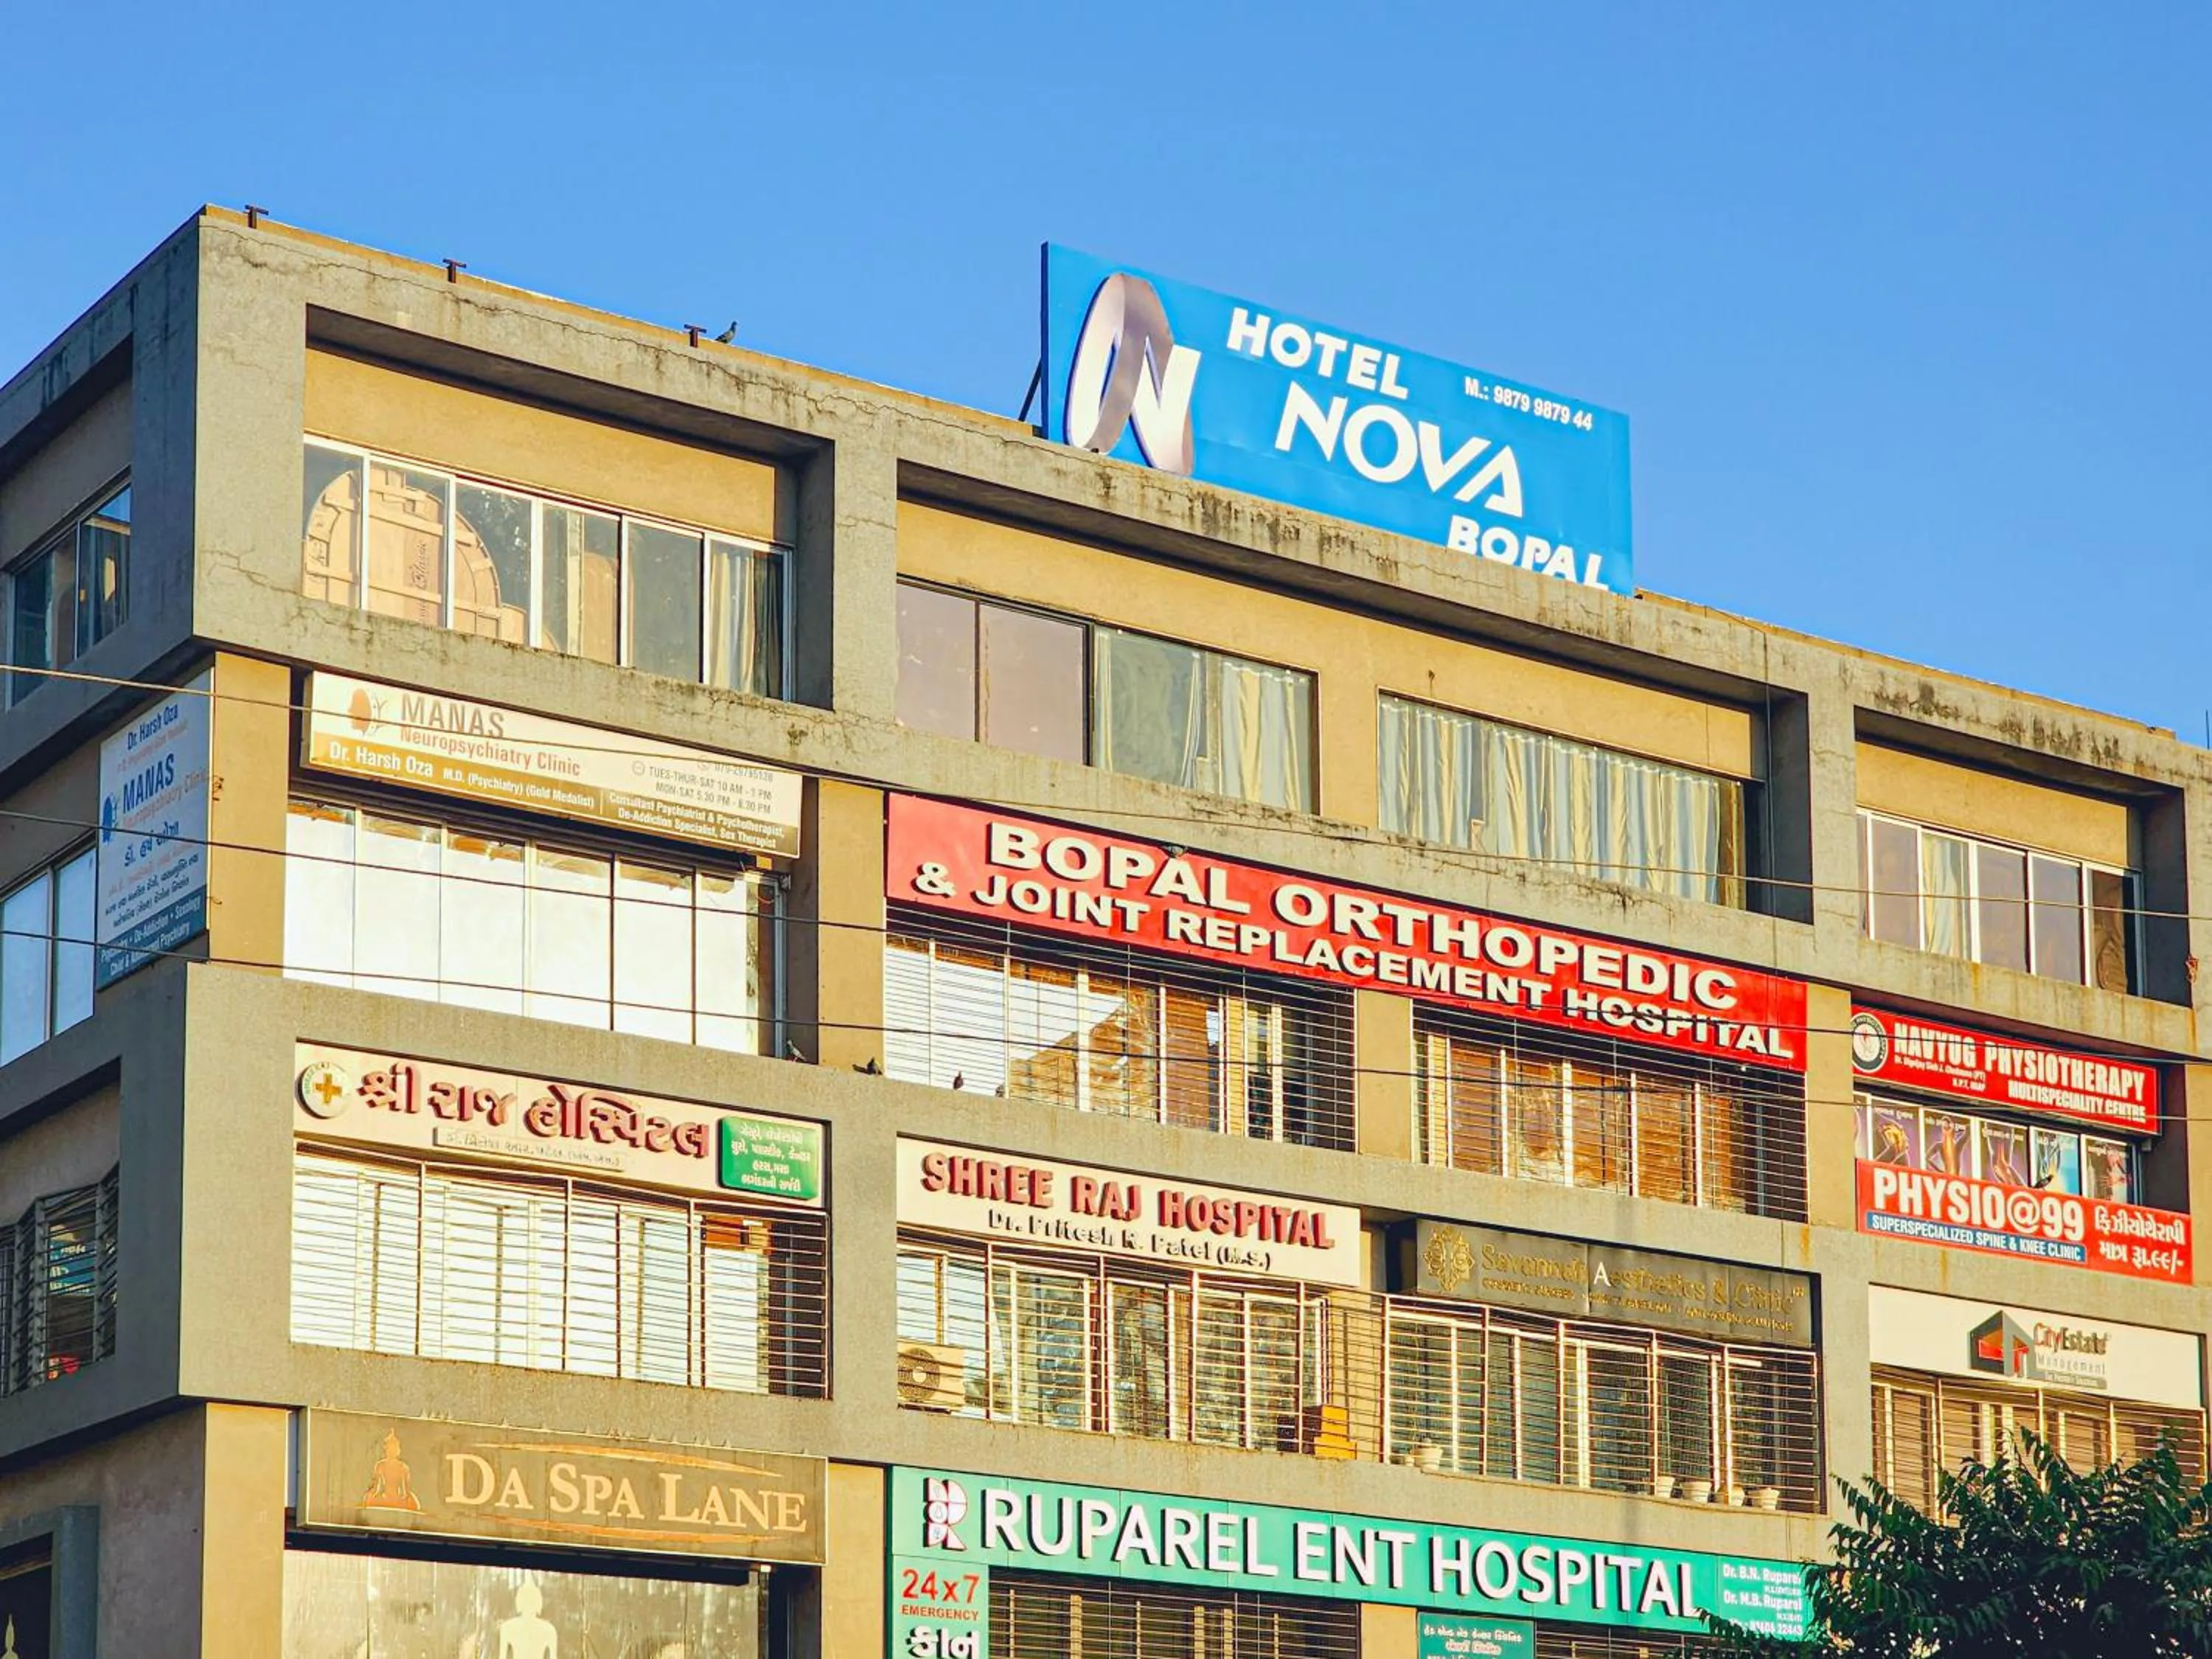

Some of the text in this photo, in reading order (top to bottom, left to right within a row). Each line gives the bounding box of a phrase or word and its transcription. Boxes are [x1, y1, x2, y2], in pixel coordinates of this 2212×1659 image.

[1226, 307, 1408, 399] HOTEL
[1494, 385, 1531, 413] 9879
[1534, 397, 1571, 425] 9879
[1573, 410, 1593, 431] 44
[1275, 380, 1523, 518] NOVA
[1447, 515, 1610, 591] BOPAL
[139, 714, 162, 742] Harsh
[163, 703, 178, 726] Oza
[401, 692, 506, 737] MANAS
[329, 741, 350, 762] Dr.
[355, 745, 401, 771] Harsh
[406, 755, 434, 779] Oza
[443, 768, 465, 783] M.D.
[468, 772, 524, 796] (Psychiatry)
[400, 726, 581, 776] Neuropsychiatry Clinic
[122, 752, 175, 814] MANAS
[987, 821, 1738, 1009] BOPAL ORTHOPEDIC
[914, 860, 956, 897] &
[972, 874, 1150, 932] JOINT
[1166, 908, 1551, 1010] REPLACEMENT
[1562, 987, 1794, 1059] HOSPITAL
[1893, 1022, 1977, 1068] NAVYUG
[1984, 1040, 2146, 1102] PHYSIOTHERAPY
[357, 1060, 420, 1116] શ્રી
[427, 1079, 517, 1127] રાજ
[524, 1084, 710, 1158] હોસ્પિટલ
[2008, 1079, 2146, 1124] MULTISPECIALITY CENTRE
[920, 1152, 1335, 1250] SHREE RAJ HOSPITAL
[1873, 1167, 2085, 1242] PHYSIO@99
[988, 1208, 1023, 1231] Dr.
[1150, 1234, 1212, 1260] Patel
[1871, 1214, 2082, 1262] SUPERSPECIALIZED SPINE & KNEE CLINIC
[2098, 1240, 2128, 1263] માત્ર
[1593, 1262, 1706, 1301] Aesthetics
[1712, 1278, 1728, 1305] &
[445, 1452, 807, 1533] DA SPA LANE
[981, 1487, 1704, 1618] RUPAREL ENT HOSPITAL
[1722, 1563, 1736, 1578] Dr.
[901, 1604, 979, 1621] EMERGENCY
[902, 1568, 980, 1604] 24x7
[1723, 1590, 1737, 1604] Dr.
[1763, 1594, 1802, 1611] Ruparel
